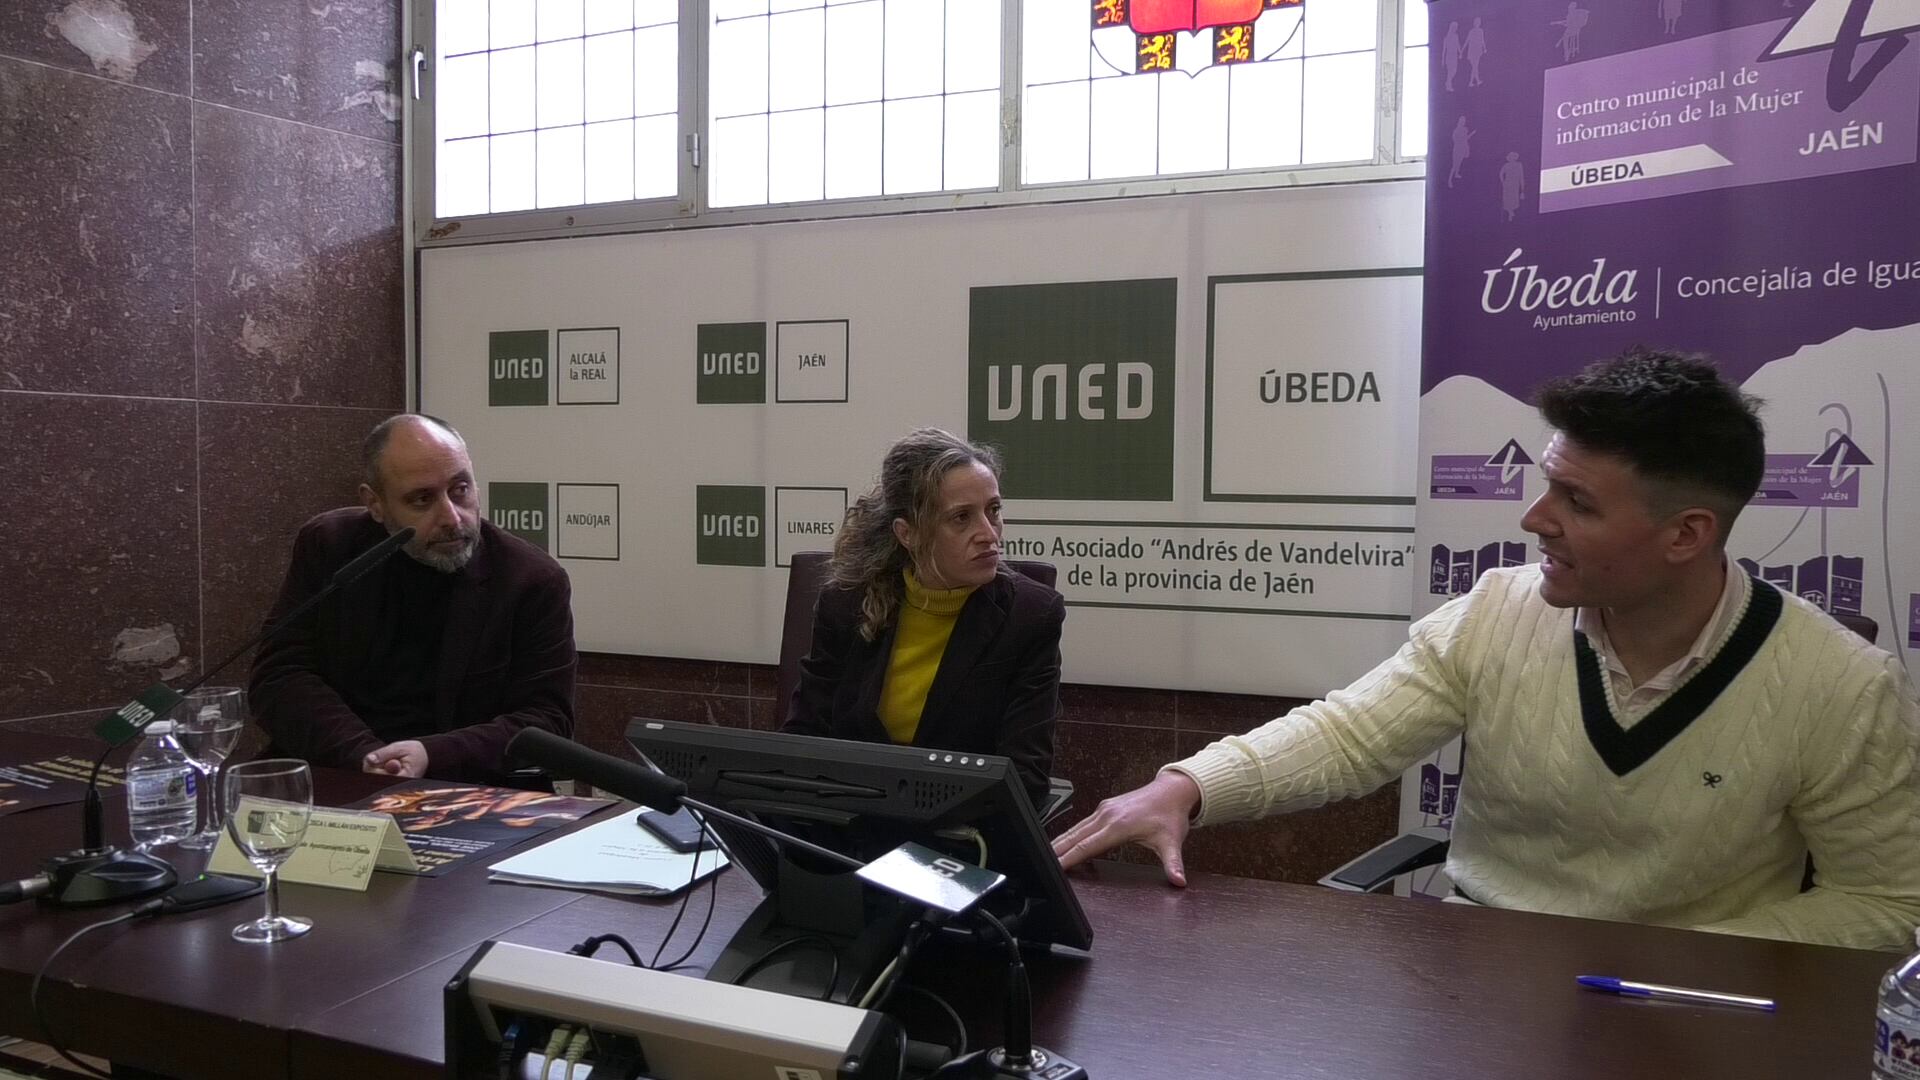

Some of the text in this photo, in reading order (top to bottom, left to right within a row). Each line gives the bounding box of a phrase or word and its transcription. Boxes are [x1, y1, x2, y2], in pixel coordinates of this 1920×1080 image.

[1556, 66, 1759, 120] Centro municipal de
[1556, 88, 1804, 145] información de la Mujer
[1799, 120, 1884, 156] JAÉN
[1571, 161, 1644, 186] ÚBEDA
[1481, 247, 1638, 314] Úbeda
[1677, 266, 1813, 299] Concejalía
[1823, 261, 1857, 287] de
[1533, 309, 1637, 331] Ayuntamiento
[494, 357, 544, 380] UNED
[569, 352, 607, 365] ALCALÁ
[703, 352, 760, 375] UNED
[798, 353, 826, 371] JAÉN
[569, 367, 607, 380] la REAL
[988, 361, 1154, 421] UNED
[1260, 369, 1381, 404] ÚBEDA
[1820, 490, 1849, 500] JAÉN
[494, 509, 544, 530] UNED
[565, 513, 611, 529] ANDÚJAR
[703, 514, 760, 538] UNED
[787, 521, 835, 535] LINARES
[1051, 536, 1144, 559] Asociado
[1151, 537, 1238, 563] “Andrés
[1244, 539, 1273, 562] de
[1067, 563, 1314, 599] de la provincia de Jaén
[117, 700, 155, 727] UNED
